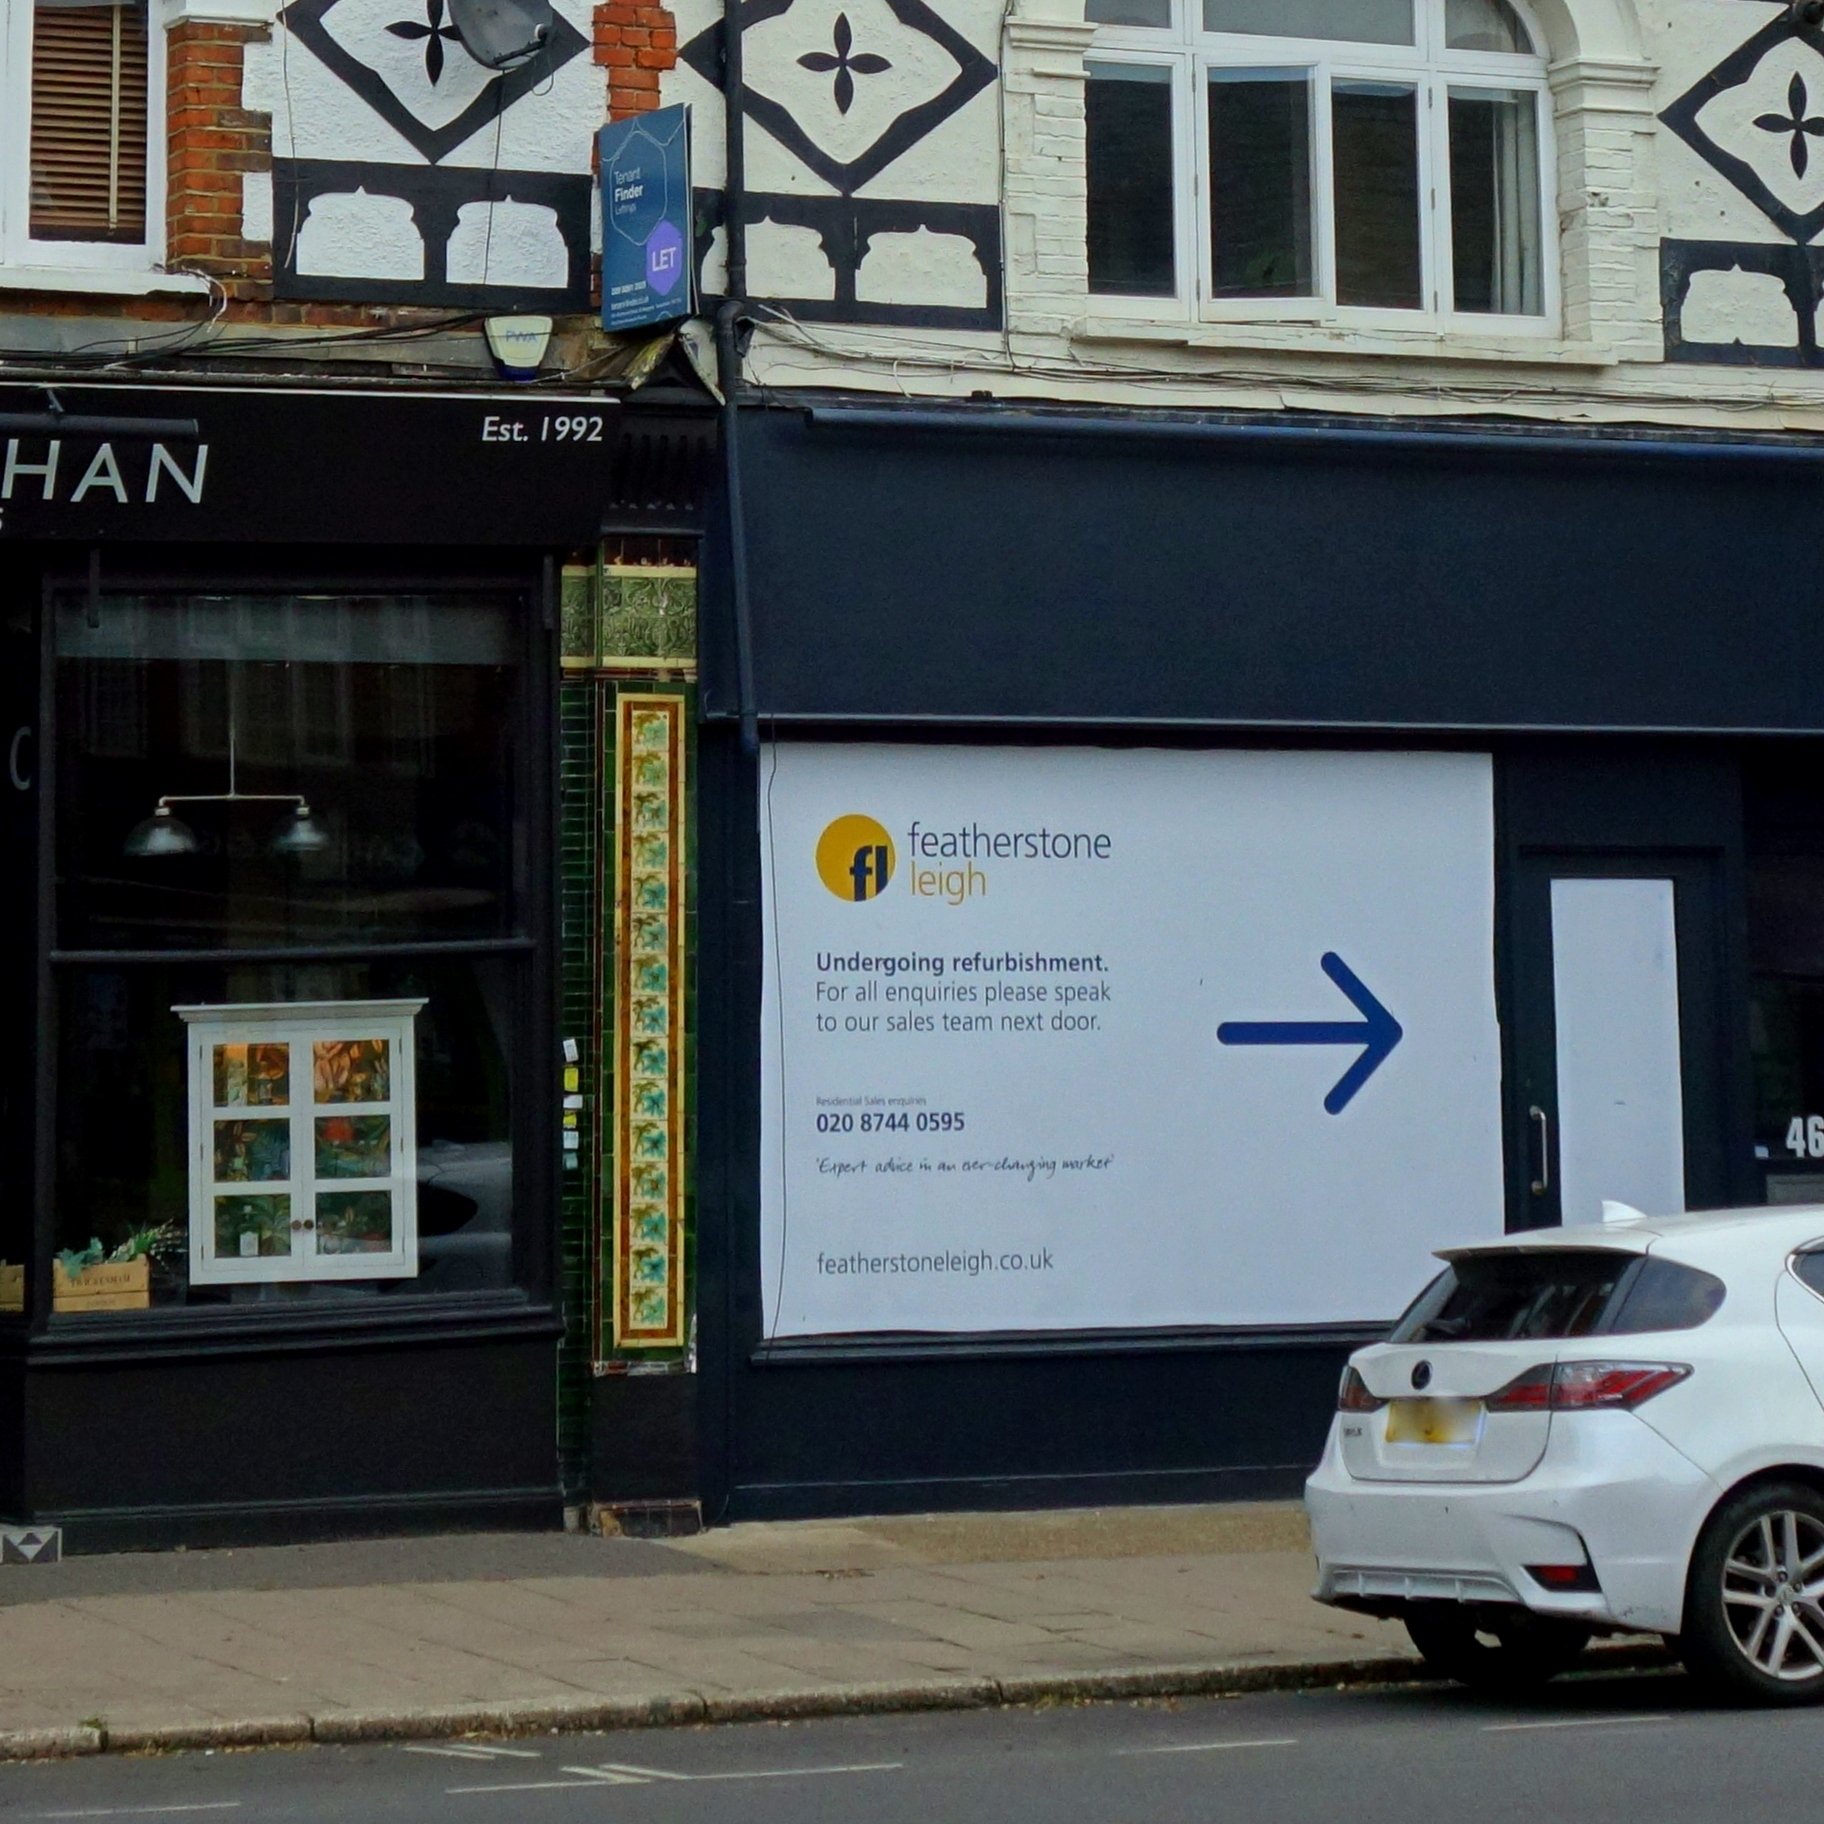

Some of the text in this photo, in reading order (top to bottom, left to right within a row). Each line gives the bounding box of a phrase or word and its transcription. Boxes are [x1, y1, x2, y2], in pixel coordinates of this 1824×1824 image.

[615, 184, 643, 202] Finder
[651, 247, 676, 272] LET
[481, 416, 603, 442] Est. 1992
[907, 821, 1112, 859] featherstone
[911, 861, 987, 906] leigh
[816, 952, 1109, 977] Undergoing refurbishment.
[816, 980, 1111, 1007] For all enquiries please speak
[816, 1010, 1101, 1032] to our sales team next door.
[864, 1095, 886, 1106] Sales
[816, 1111, 965, 1133] 020 8744 0595
[875, 1157, 913, 1173] advice
[919, 1158, 932, 1172] in
[937, 1161, 956, 1173] an
[817, 1247, 1054, 1276] featherstoneleigh.co.uk
